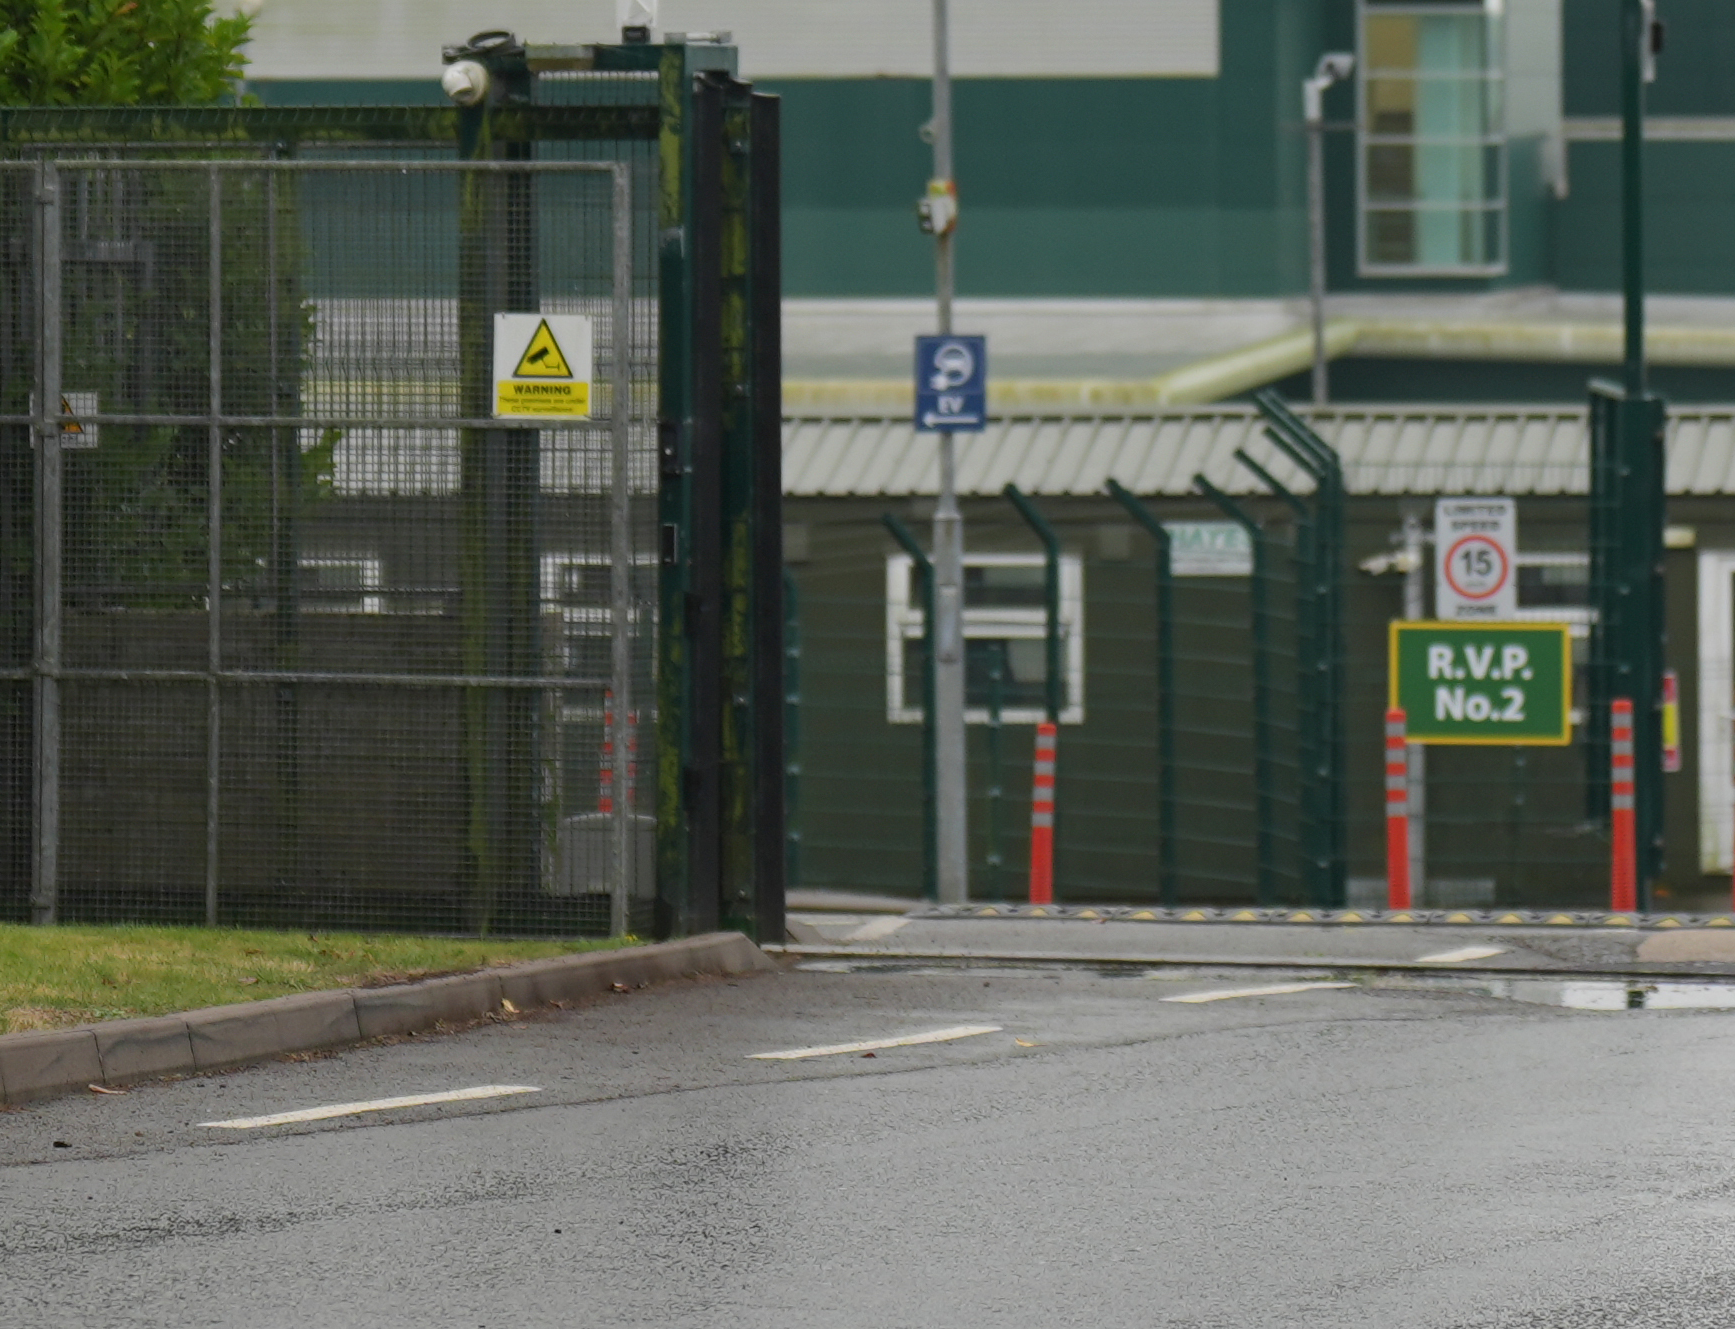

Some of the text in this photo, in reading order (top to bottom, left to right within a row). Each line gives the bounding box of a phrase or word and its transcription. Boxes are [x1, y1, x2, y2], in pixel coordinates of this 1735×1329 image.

[512, 384, 572, 395] WARNING
[937, 395, 965, 414] EV
[1450, 519, 1501, 531] SPEED
[1460, 549, 1493, 576] 15
[1455, 603, 1497, 616] ZONE
[1427, 643, 1534, 681] R.V.P.
[1434, 685, 1526, 722] No.2
